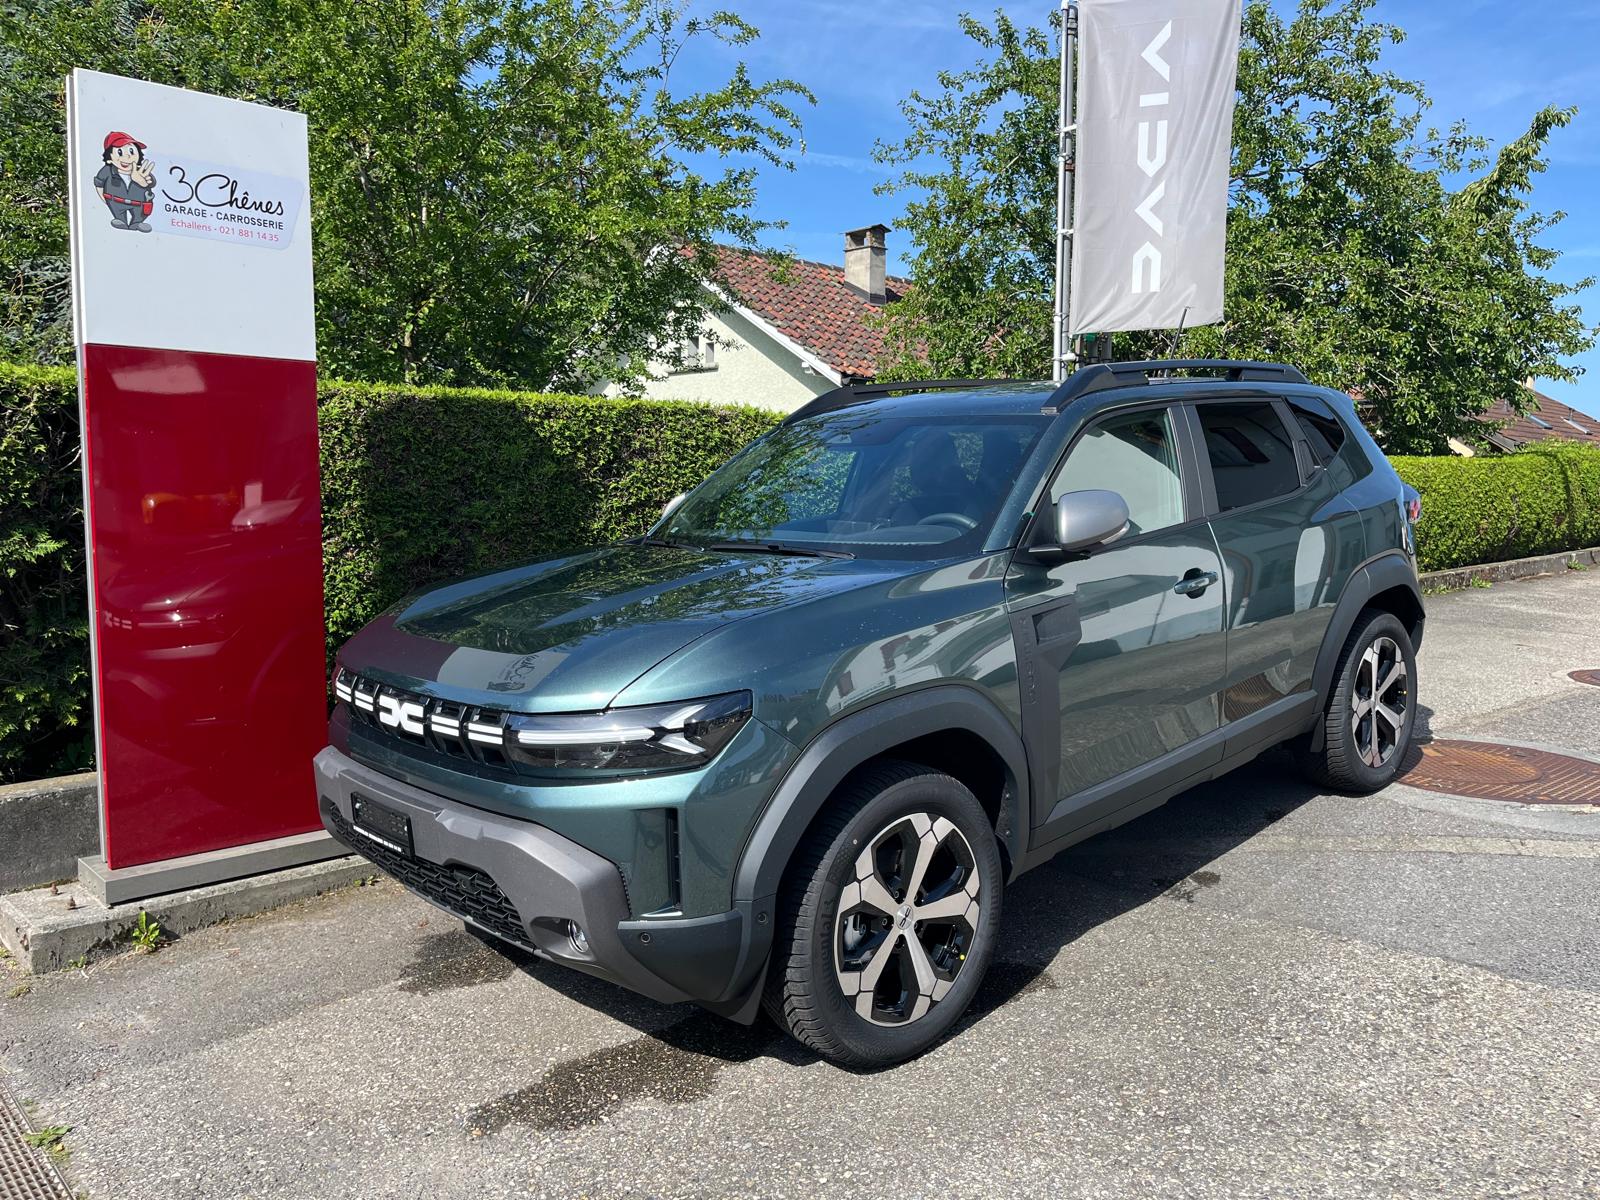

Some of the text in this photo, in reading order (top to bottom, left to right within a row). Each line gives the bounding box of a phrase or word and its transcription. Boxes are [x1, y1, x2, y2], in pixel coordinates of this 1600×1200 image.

[1131, 19, 1172, 294] DACIA
[164, 203, 208, 218] GARAGE
[216, 211, 284, 230] CARROSSERIE
[171, 218, 212, 232] Echallens
[219, 225, 235, 235] 021
[238, 228, 254, 239] 881
